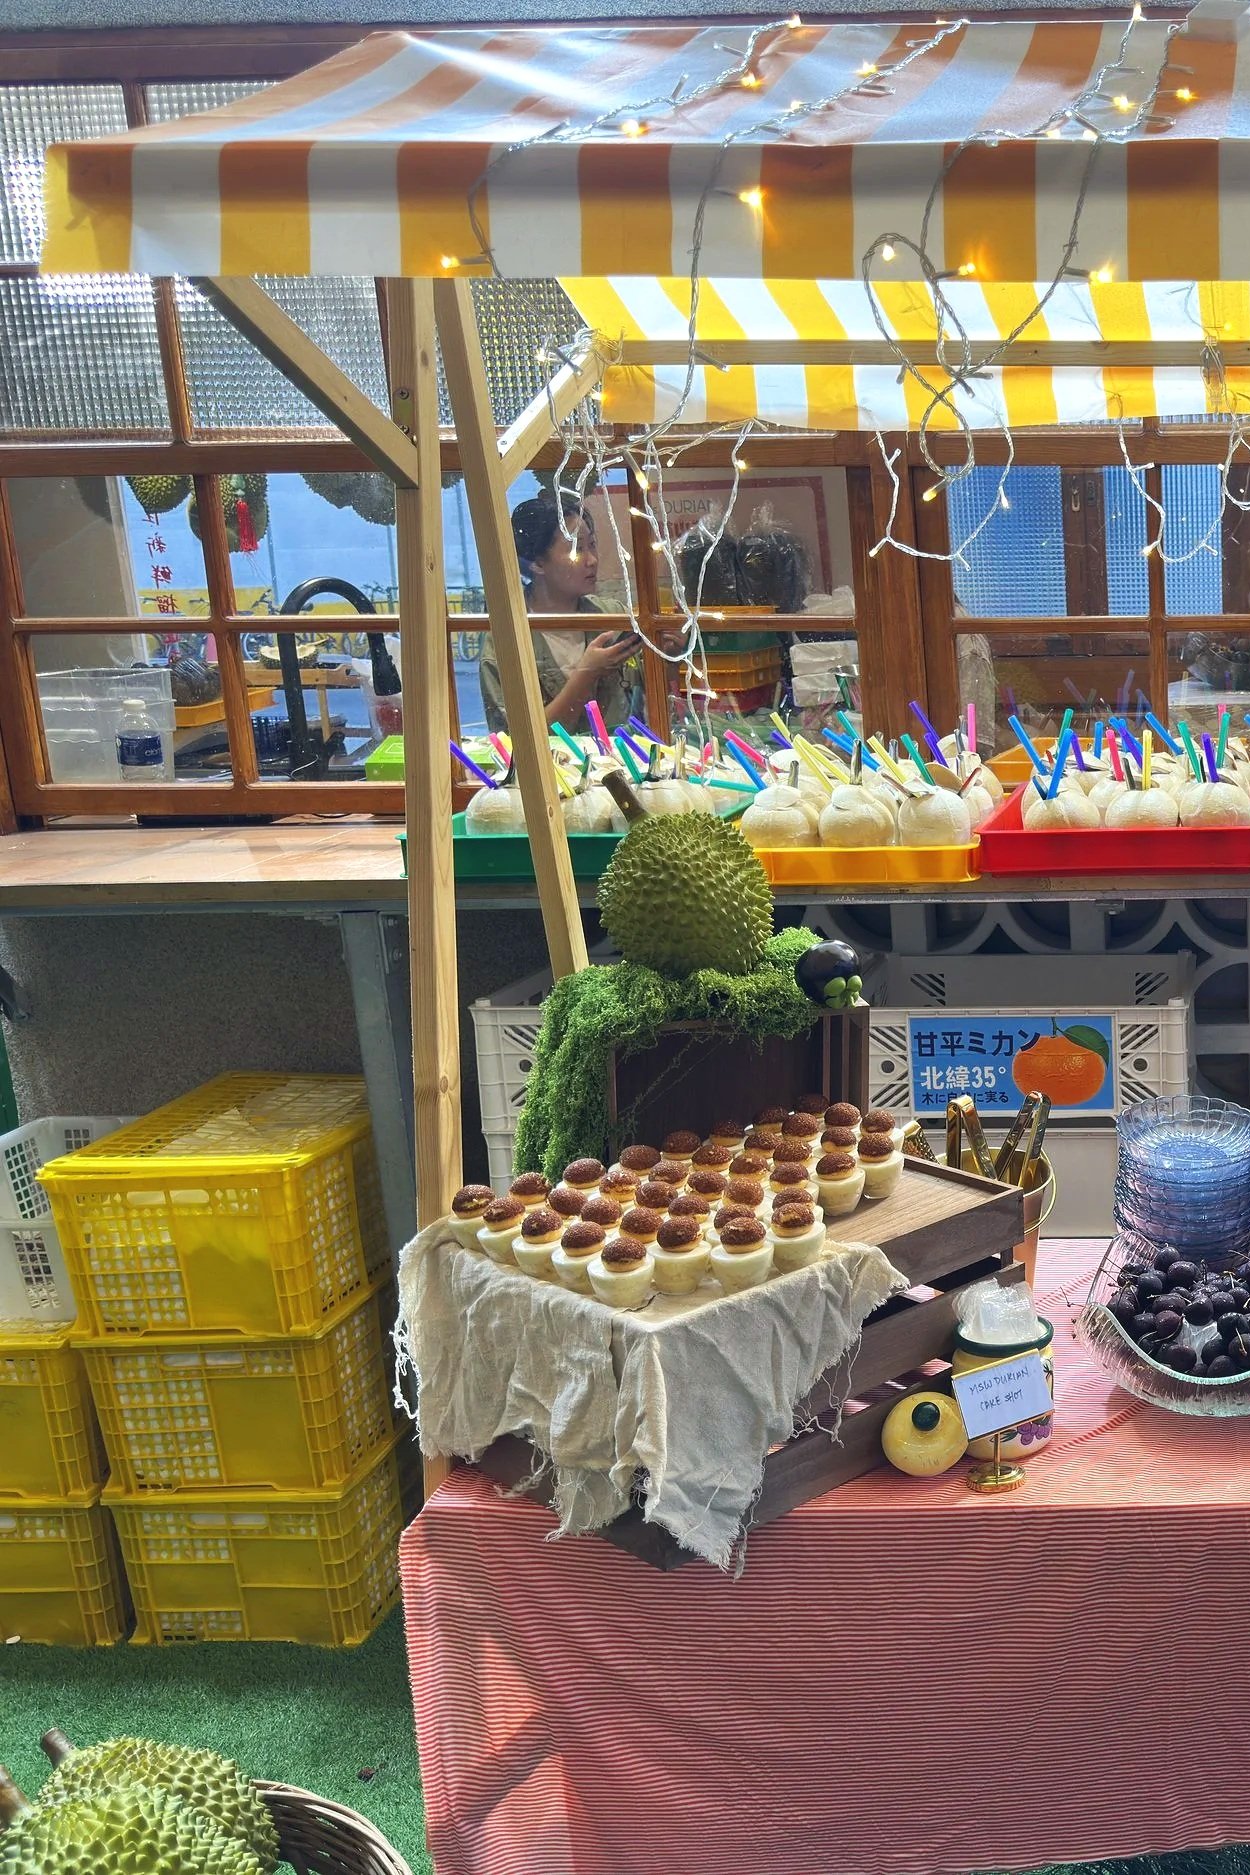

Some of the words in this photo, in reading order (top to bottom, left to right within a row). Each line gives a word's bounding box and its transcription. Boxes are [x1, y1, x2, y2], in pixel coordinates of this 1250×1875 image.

[914, 1030, 1041, 1057] 甘平ミカン
[922, 1091, 1009, 1105] 木に自に実る
[980, 1396, 1001, 1411] CAKE
[1004, 1388, 1023, 1403] SHOT
